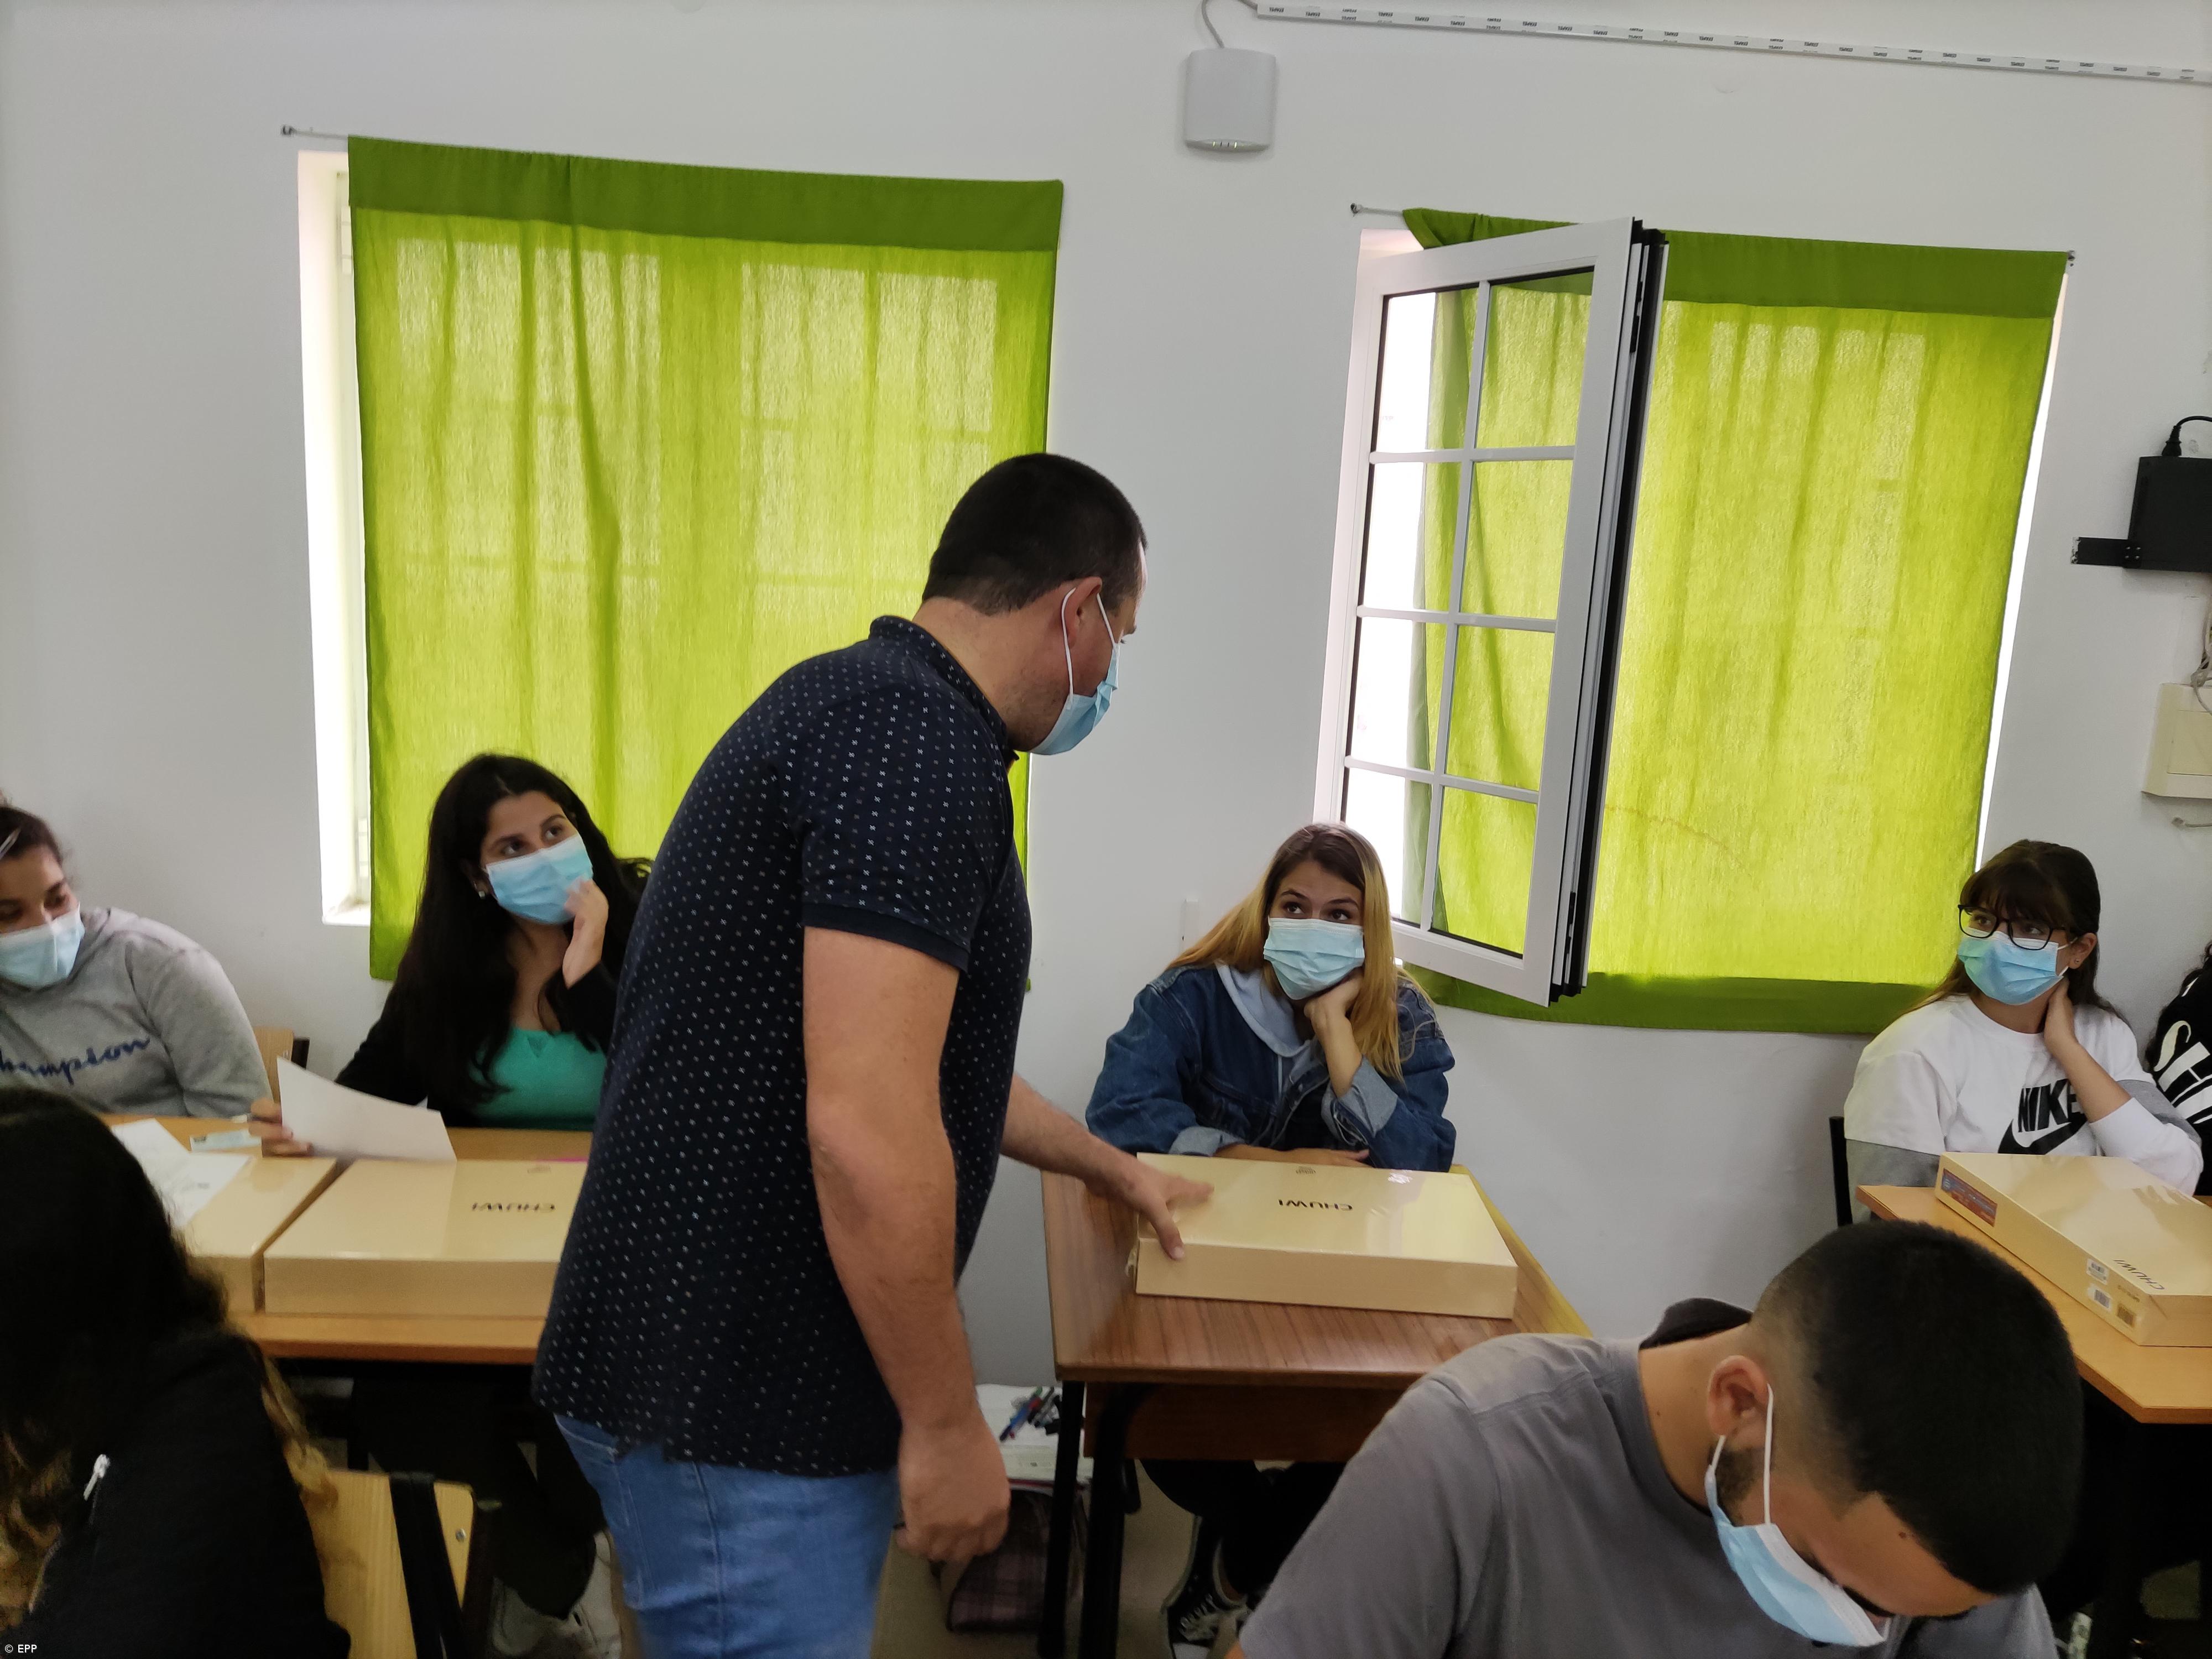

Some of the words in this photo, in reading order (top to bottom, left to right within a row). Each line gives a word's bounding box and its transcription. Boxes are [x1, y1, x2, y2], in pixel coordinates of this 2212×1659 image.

[0, 1035, 150, 1086] hampion
[2017, 1078, 2083, 1133] NIKE
[1278, 1199, 1353, 1211] CHUWI
[2113, 1259, 2165, 1290] CHUWI
